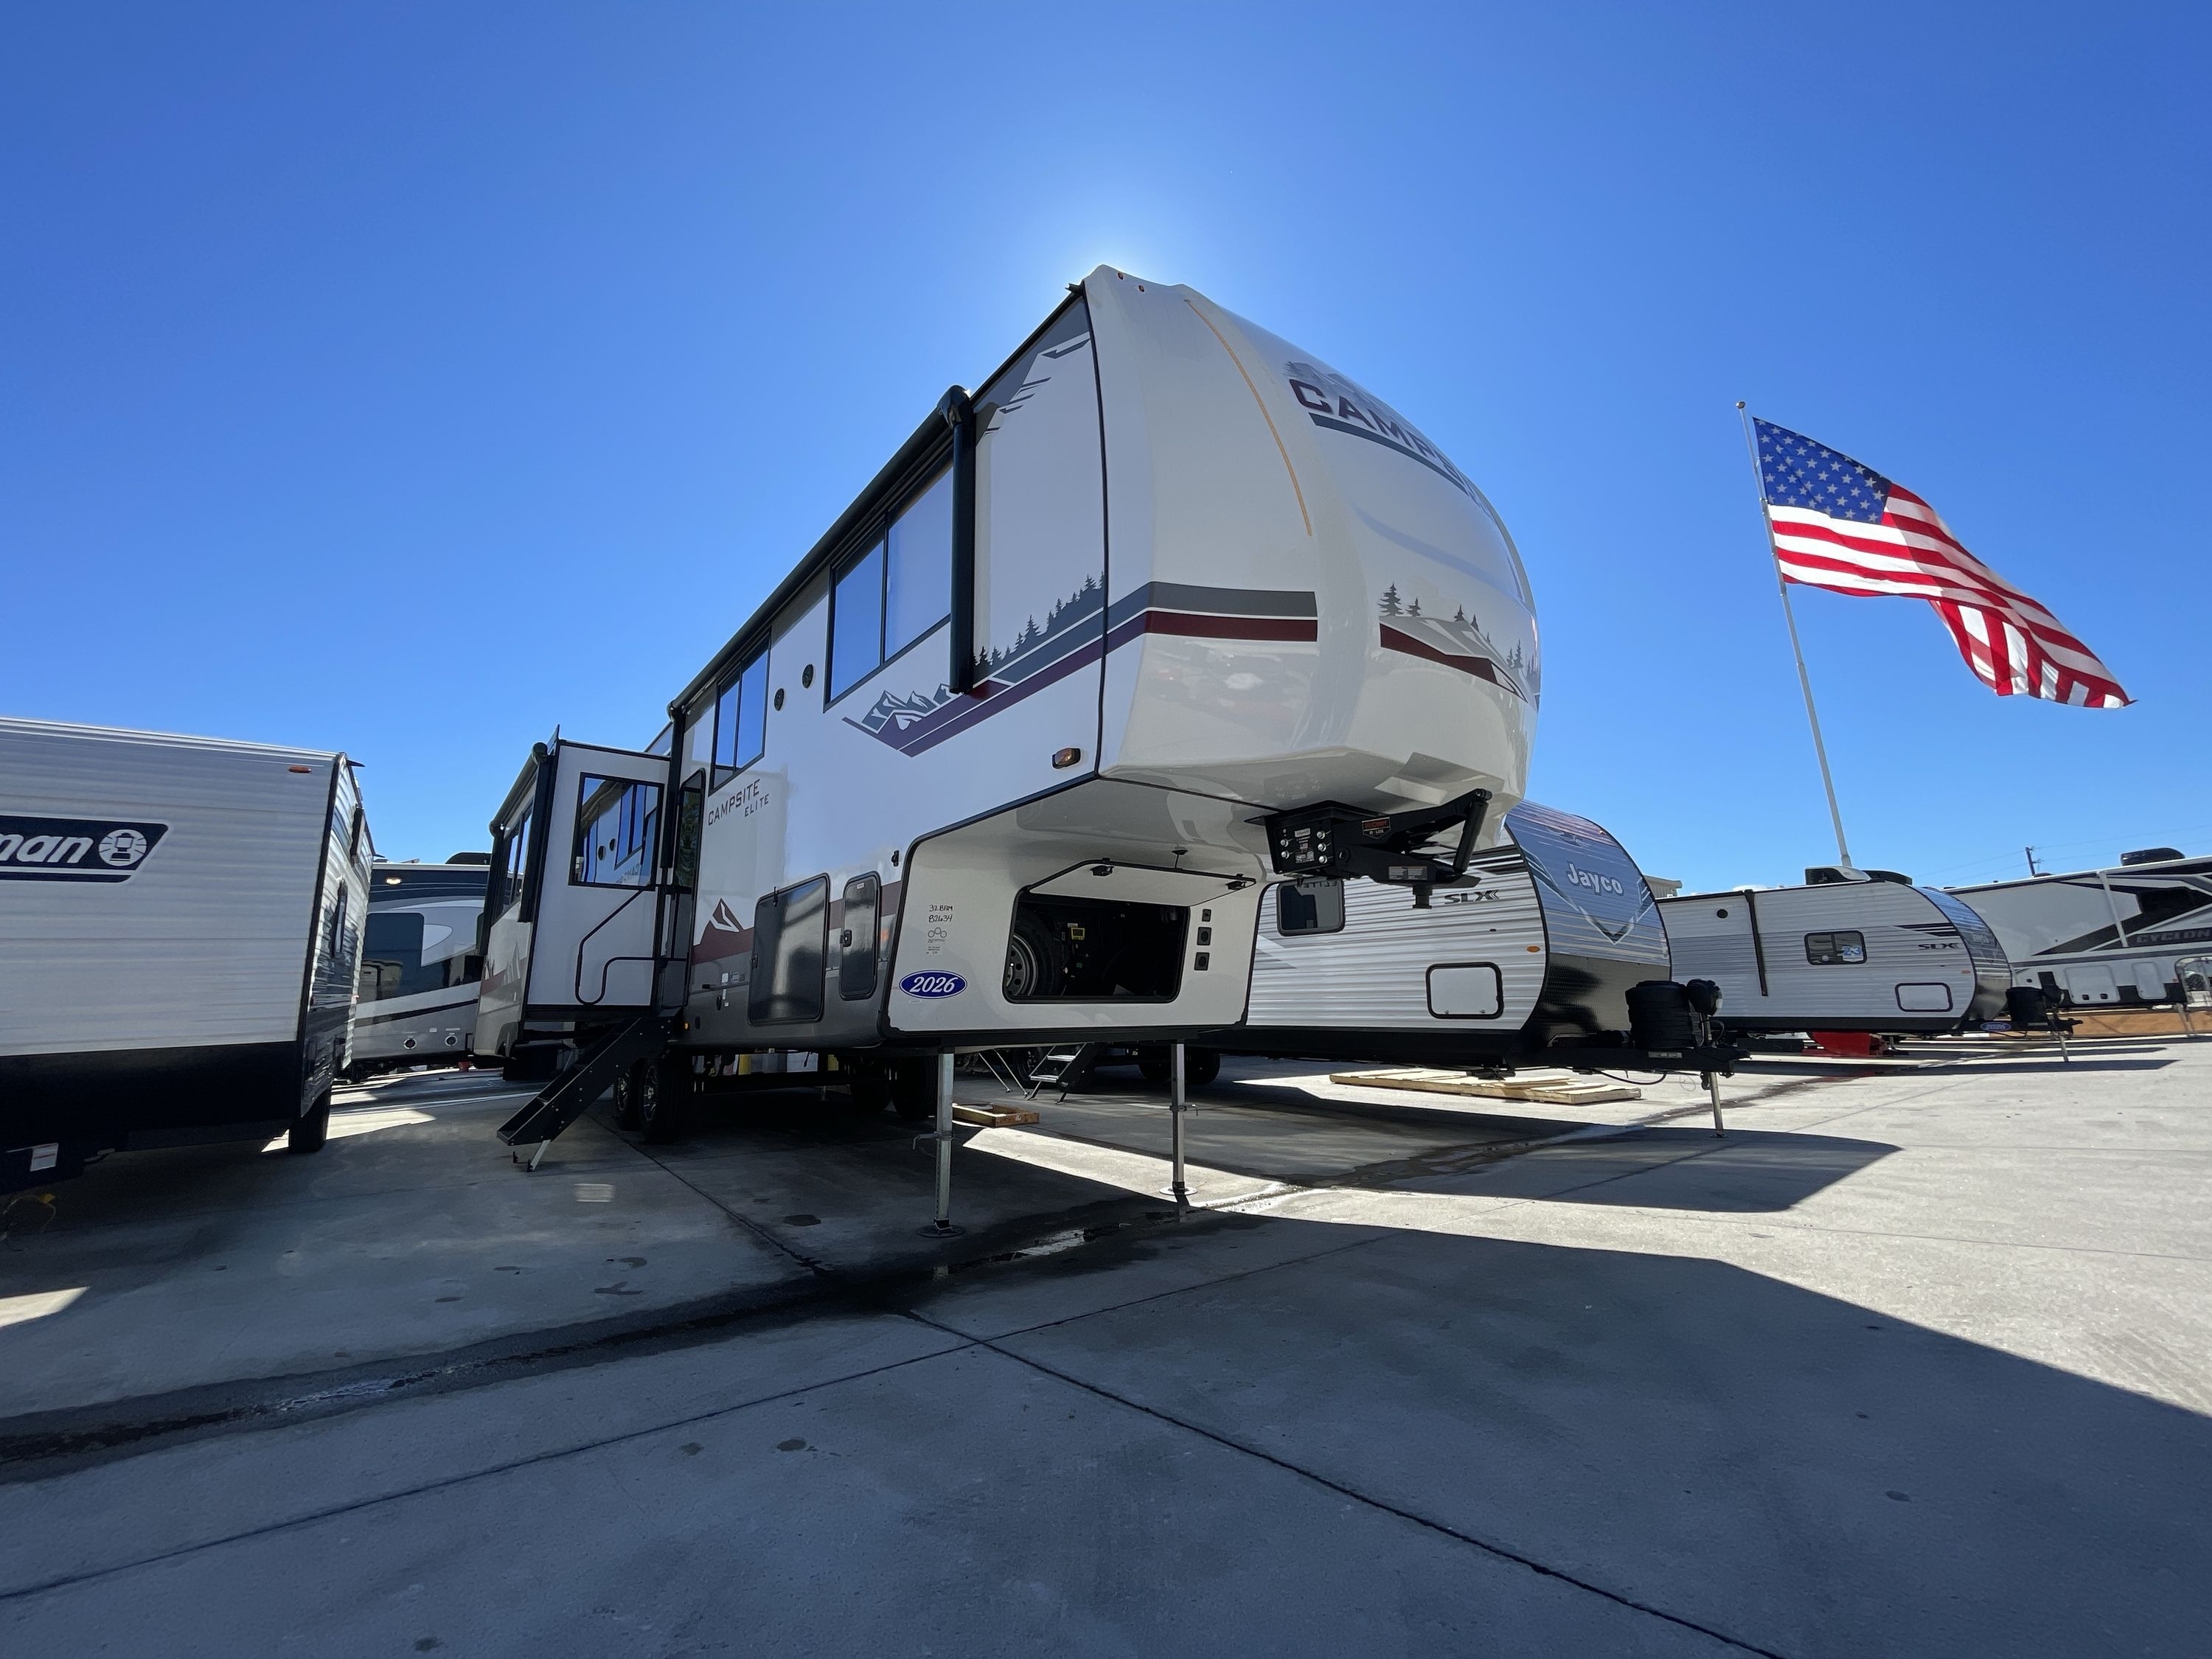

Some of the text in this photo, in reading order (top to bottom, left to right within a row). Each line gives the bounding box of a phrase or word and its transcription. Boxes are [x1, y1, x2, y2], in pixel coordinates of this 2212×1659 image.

[708, 778, 761, 826] CAMPSITE
[744, 793, 769, 817] ELITE
[1565, 860, 1624, 897] Jayco
[909, 976, 959, 993] 2026
